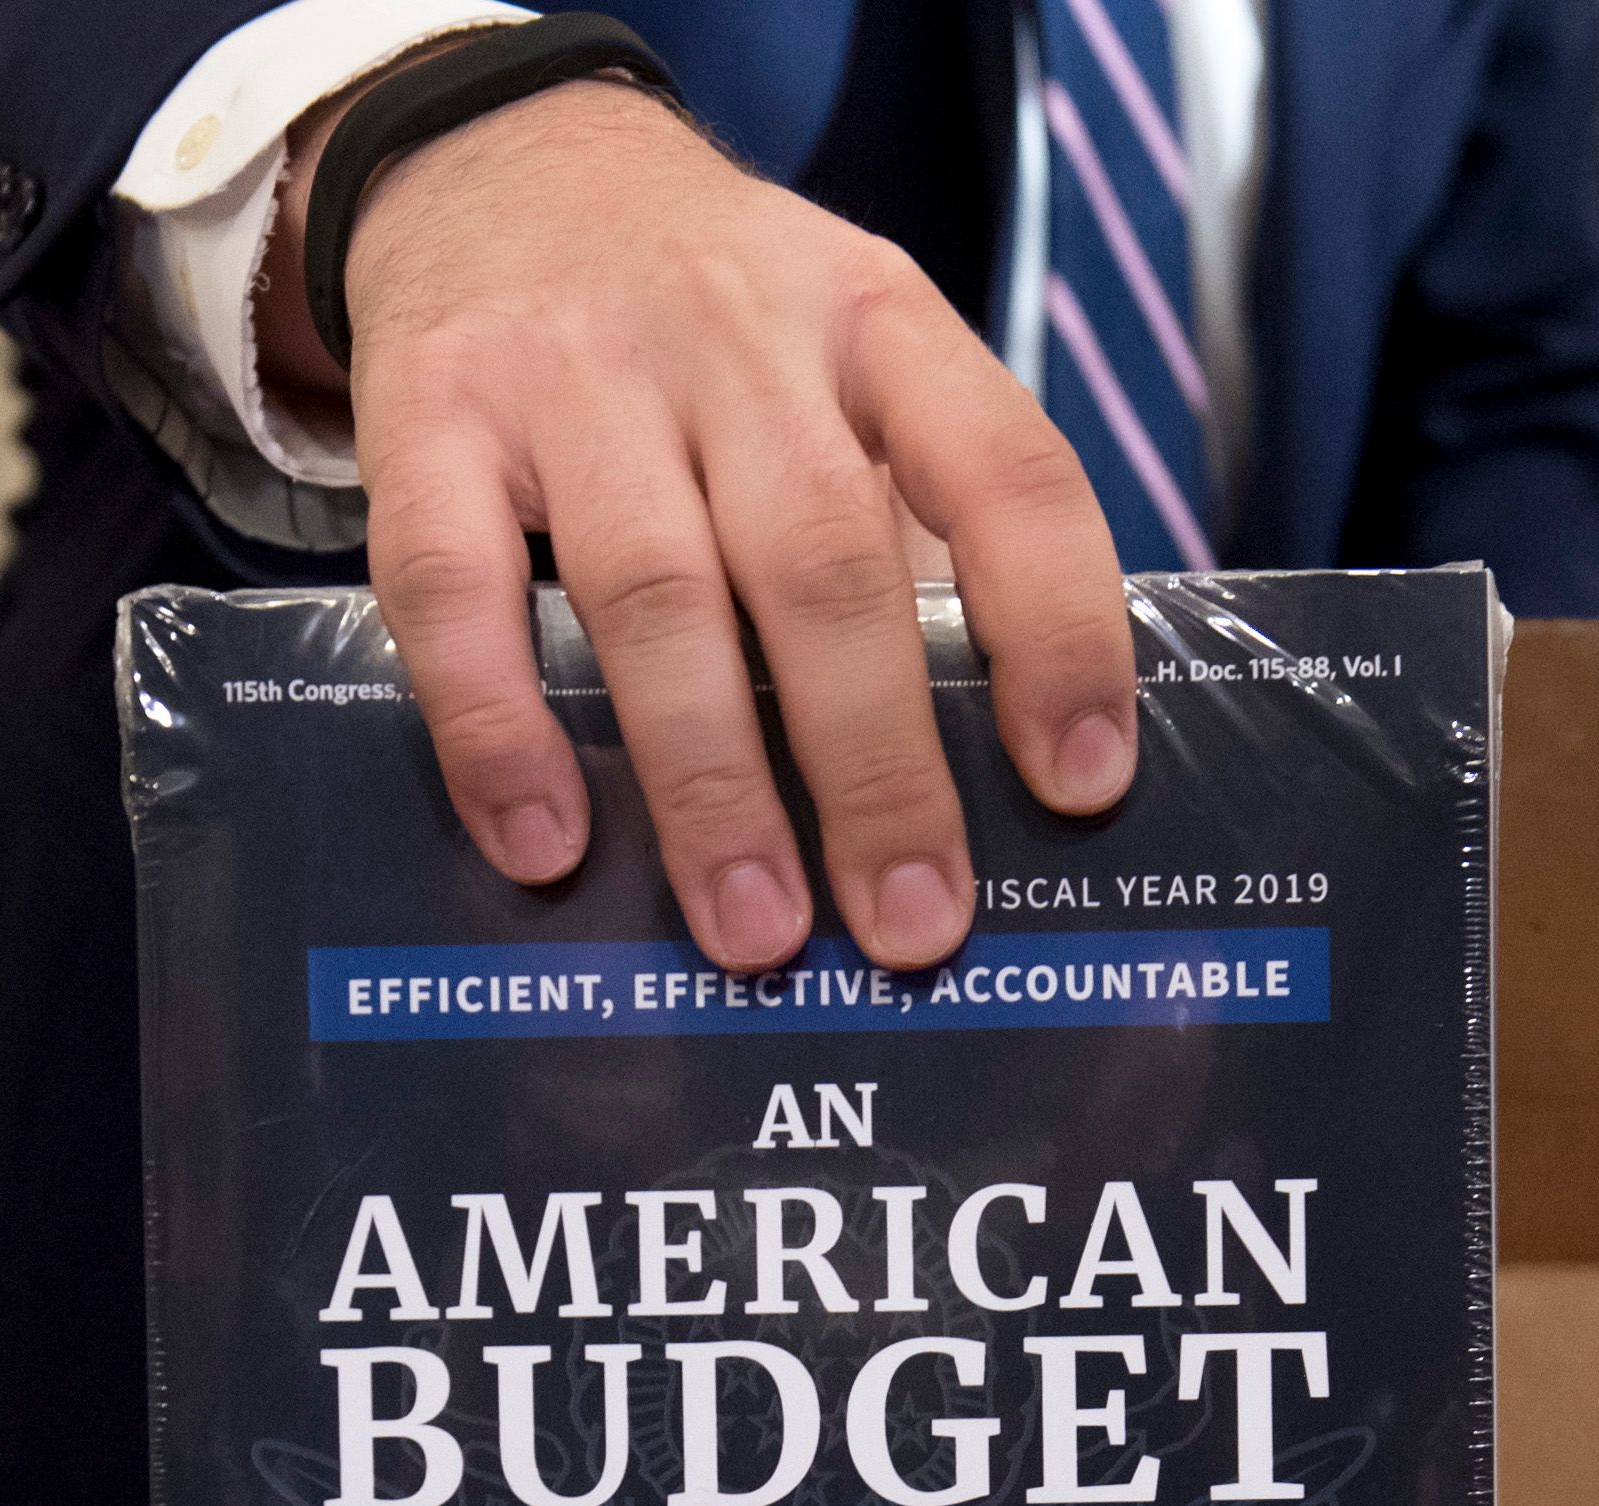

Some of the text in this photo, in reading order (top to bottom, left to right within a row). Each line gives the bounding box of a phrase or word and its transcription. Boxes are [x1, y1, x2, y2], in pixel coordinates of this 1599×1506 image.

[223, 680, 282, 702] 115th
[288, 679, 401, 705] Congress,
[1190, 660, 1242, 682] Doc.
[1343, 655, 1387, 677] Vol.
[1395, 655, 1401, 676] I
[974, 873, 1328, 910] ISCAL YEAR 2019
[349, 961, 1289, 1018] EFFICIENT, EFFECTIVE, ACCOUNTABLE
[753, 1083, 878, 1148] AN
[319, 1179, 1317, 1321] AMERICAN
